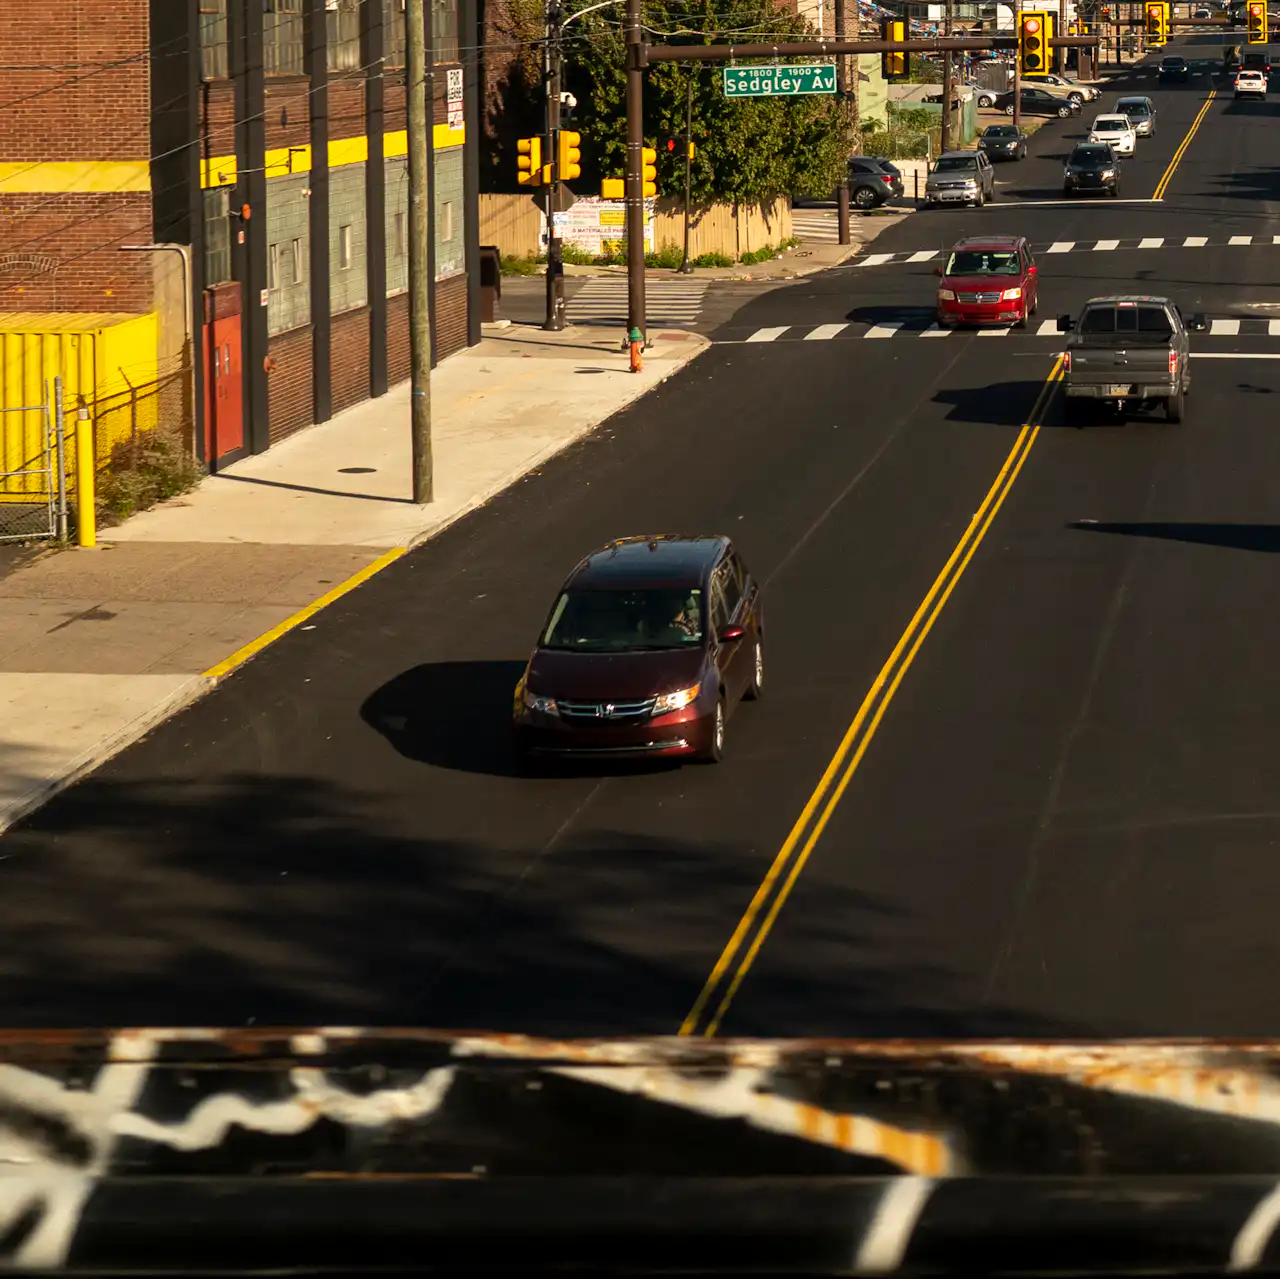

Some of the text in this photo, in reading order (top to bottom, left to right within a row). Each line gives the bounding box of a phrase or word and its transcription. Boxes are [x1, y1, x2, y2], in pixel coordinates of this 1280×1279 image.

[449, 71, 461, 86] FOR
[776, 68, 782, 77] E
[788, 68, 811, 76] 1900
[727, 76, 834, 94] Sedgley Av
[449, 86, 462, 100] LEASE
